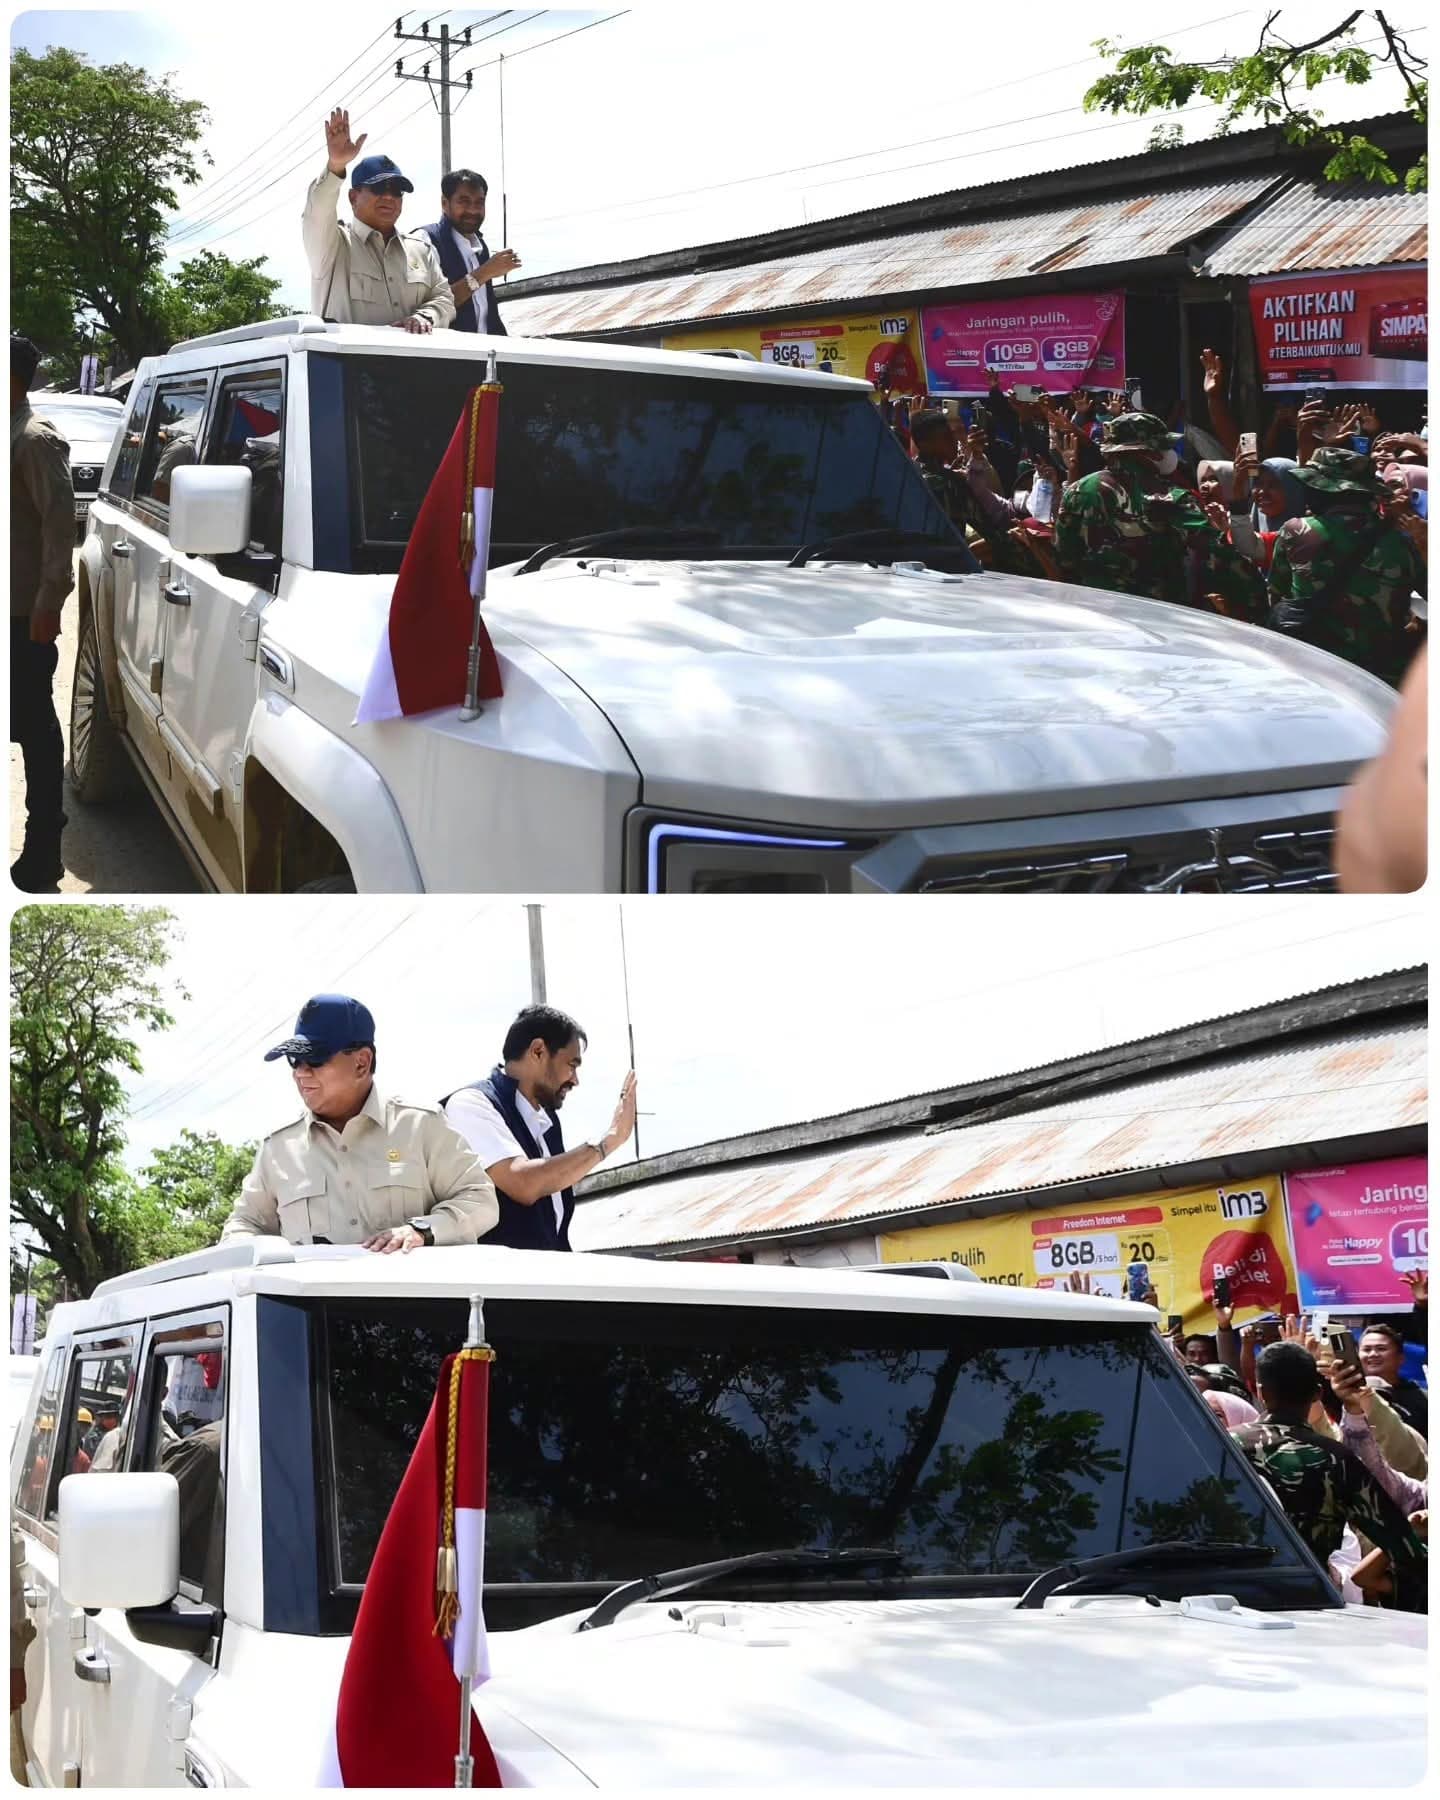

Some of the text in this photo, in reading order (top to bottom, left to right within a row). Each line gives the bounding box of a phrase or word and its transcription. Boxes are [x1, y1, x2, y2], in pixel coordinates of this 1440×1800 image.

[1263, 290, 1355, 319] AKTIFKAN
[967, 312, 1070, 328] Jaringan pulih,
[1274, 318, 1343, 343] PILIHAN
[773, 344, 800, 362] 8GB
[822, 347, 838, 361] 20
[1269, 343, 1361, 360] #TERBAIKUNTUKMU
[1170, 1203, 1217, 1217] Simpel itu
[1218, 1189, 1268, 1218] im3
[1063, 1213, 1127, 1229] Freedom Internet
[1344, 1237, 1383, 1249] Happy
[951, 1247, 986, 1267] Pulih
[1051, 1240, 1095, 1268] 8GB
[1129, 1241, 1155, 1263] 20
[1249, 1248, 1267, 1263] di
